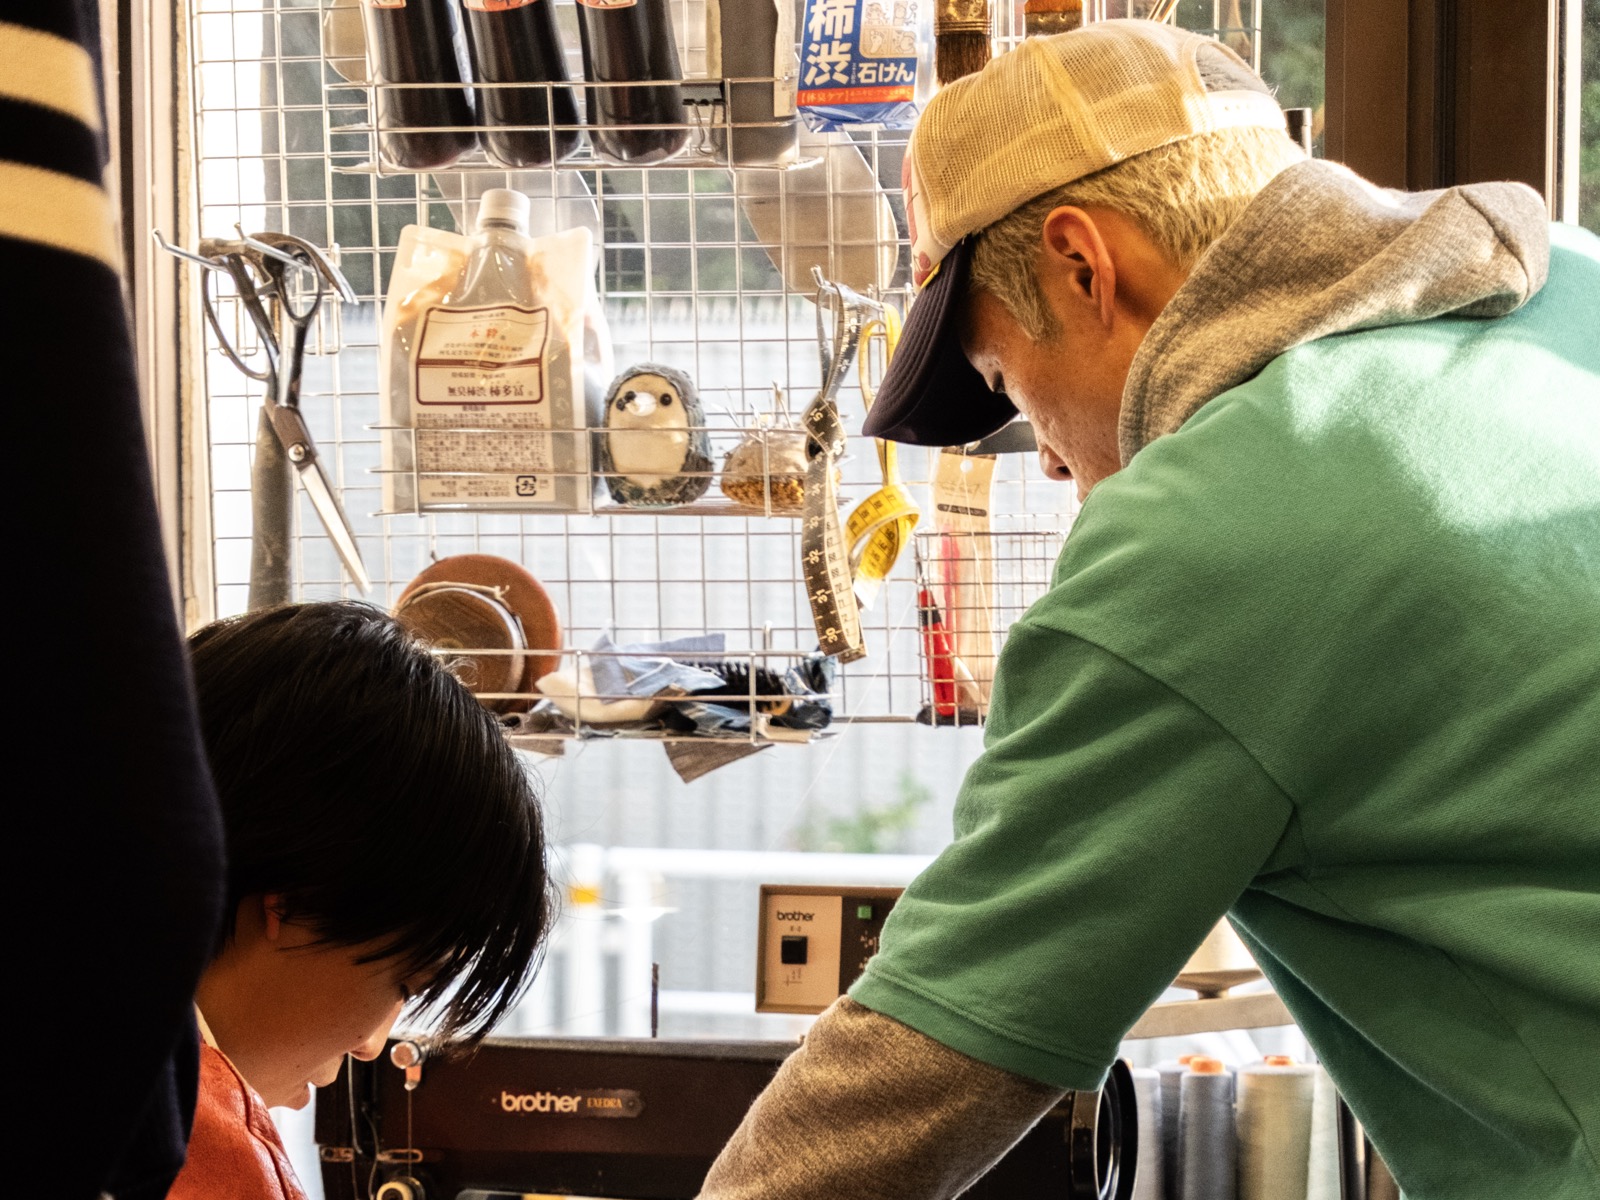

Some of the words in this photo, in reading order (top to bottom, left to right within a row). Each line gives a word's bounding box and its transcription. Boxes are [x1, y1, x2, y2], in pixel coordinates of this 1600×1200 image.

[803, 0, 857, 86] 柿渋
[857, 62, 914, 84] 石けん
[808, 549, 820, 565] 32
[816, 588, 828, 604] 31
[825, 627, 838, 643] 30
[777, 910, 814, 921] brother
[501, 1090, 582, 1112] brother
